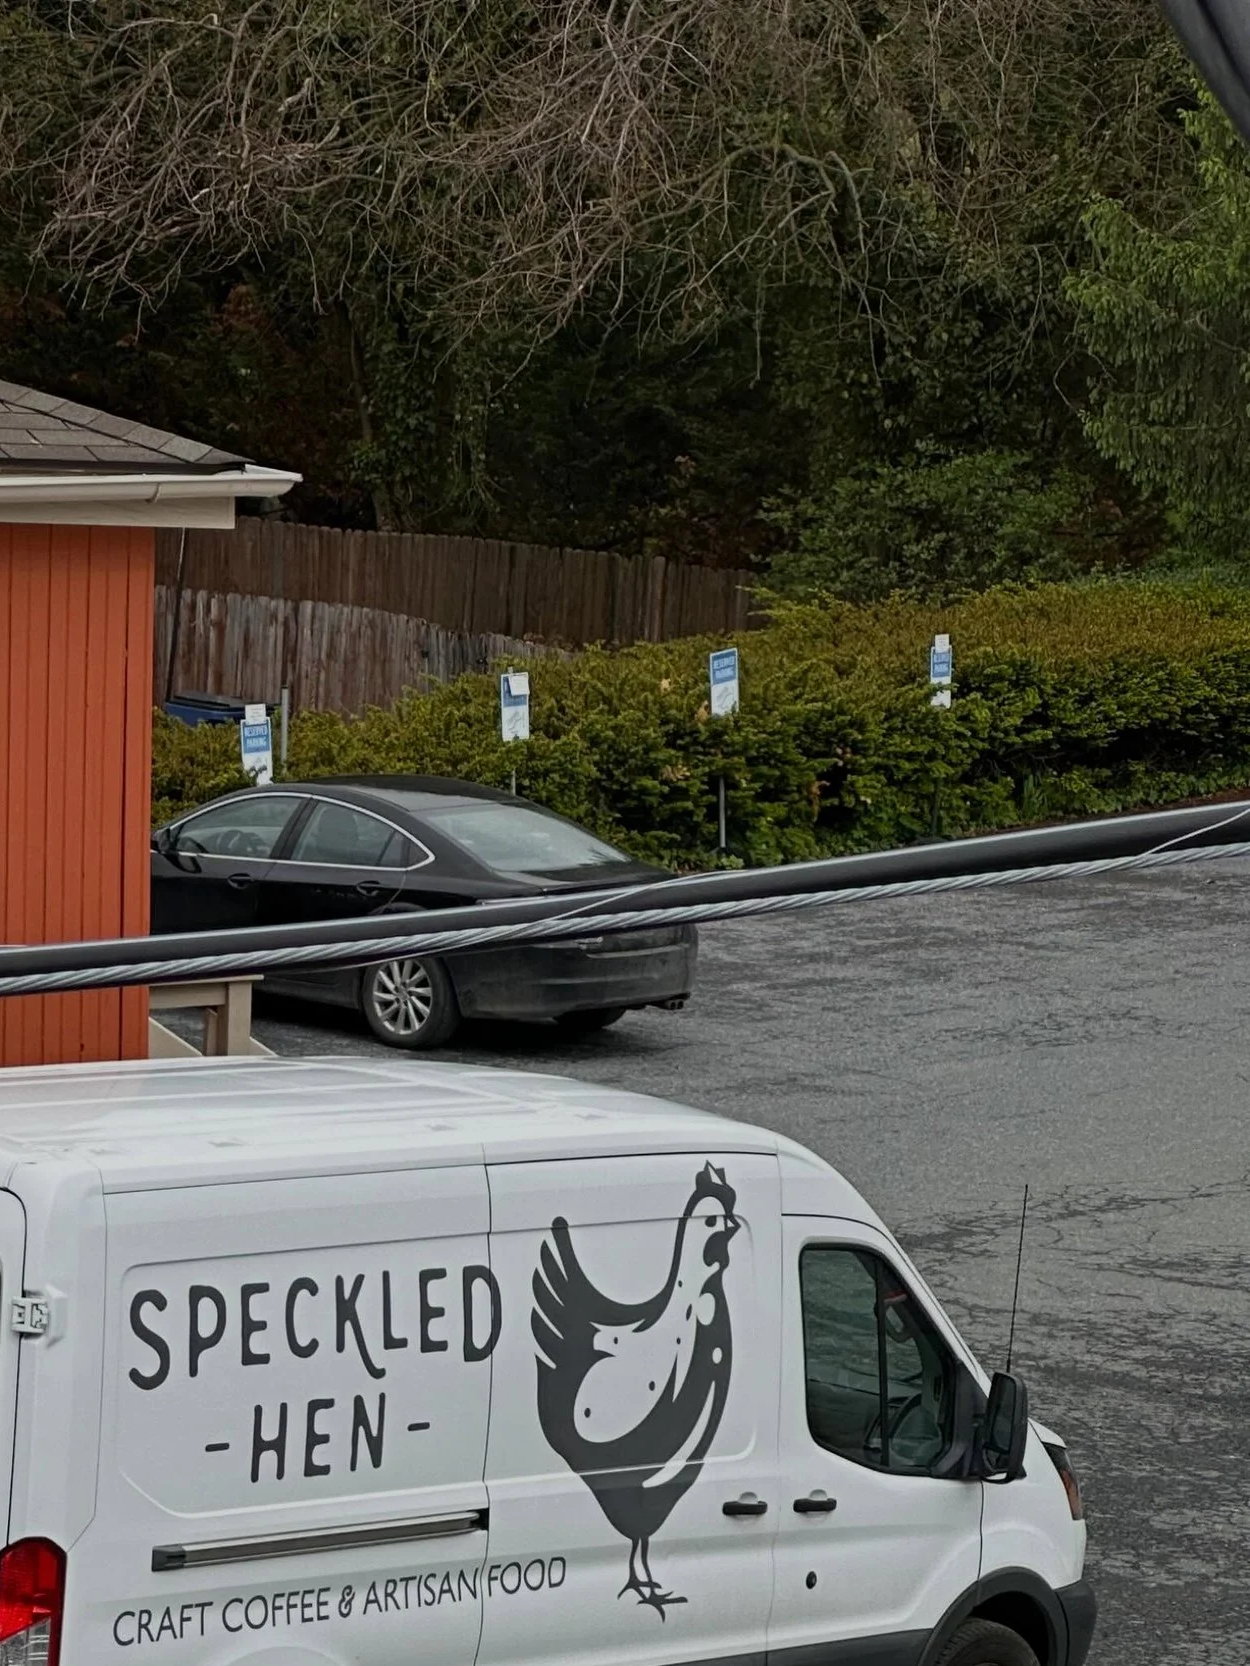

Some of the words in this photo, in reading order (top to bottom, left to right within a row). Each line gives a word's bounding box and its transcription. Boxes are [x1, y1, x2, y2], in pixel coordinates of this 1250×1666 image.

[128, 1265, 502, 1391] SPECKLED
[113, 1600, 215, 1647] CRAFT
[221, 1586, 332, 1633] COFFEE
[337, 1584, 356, 1619] &
[362, 1566, 480, 1616] ARTISAN
[486, 1556, 567, 1598] FOOD
